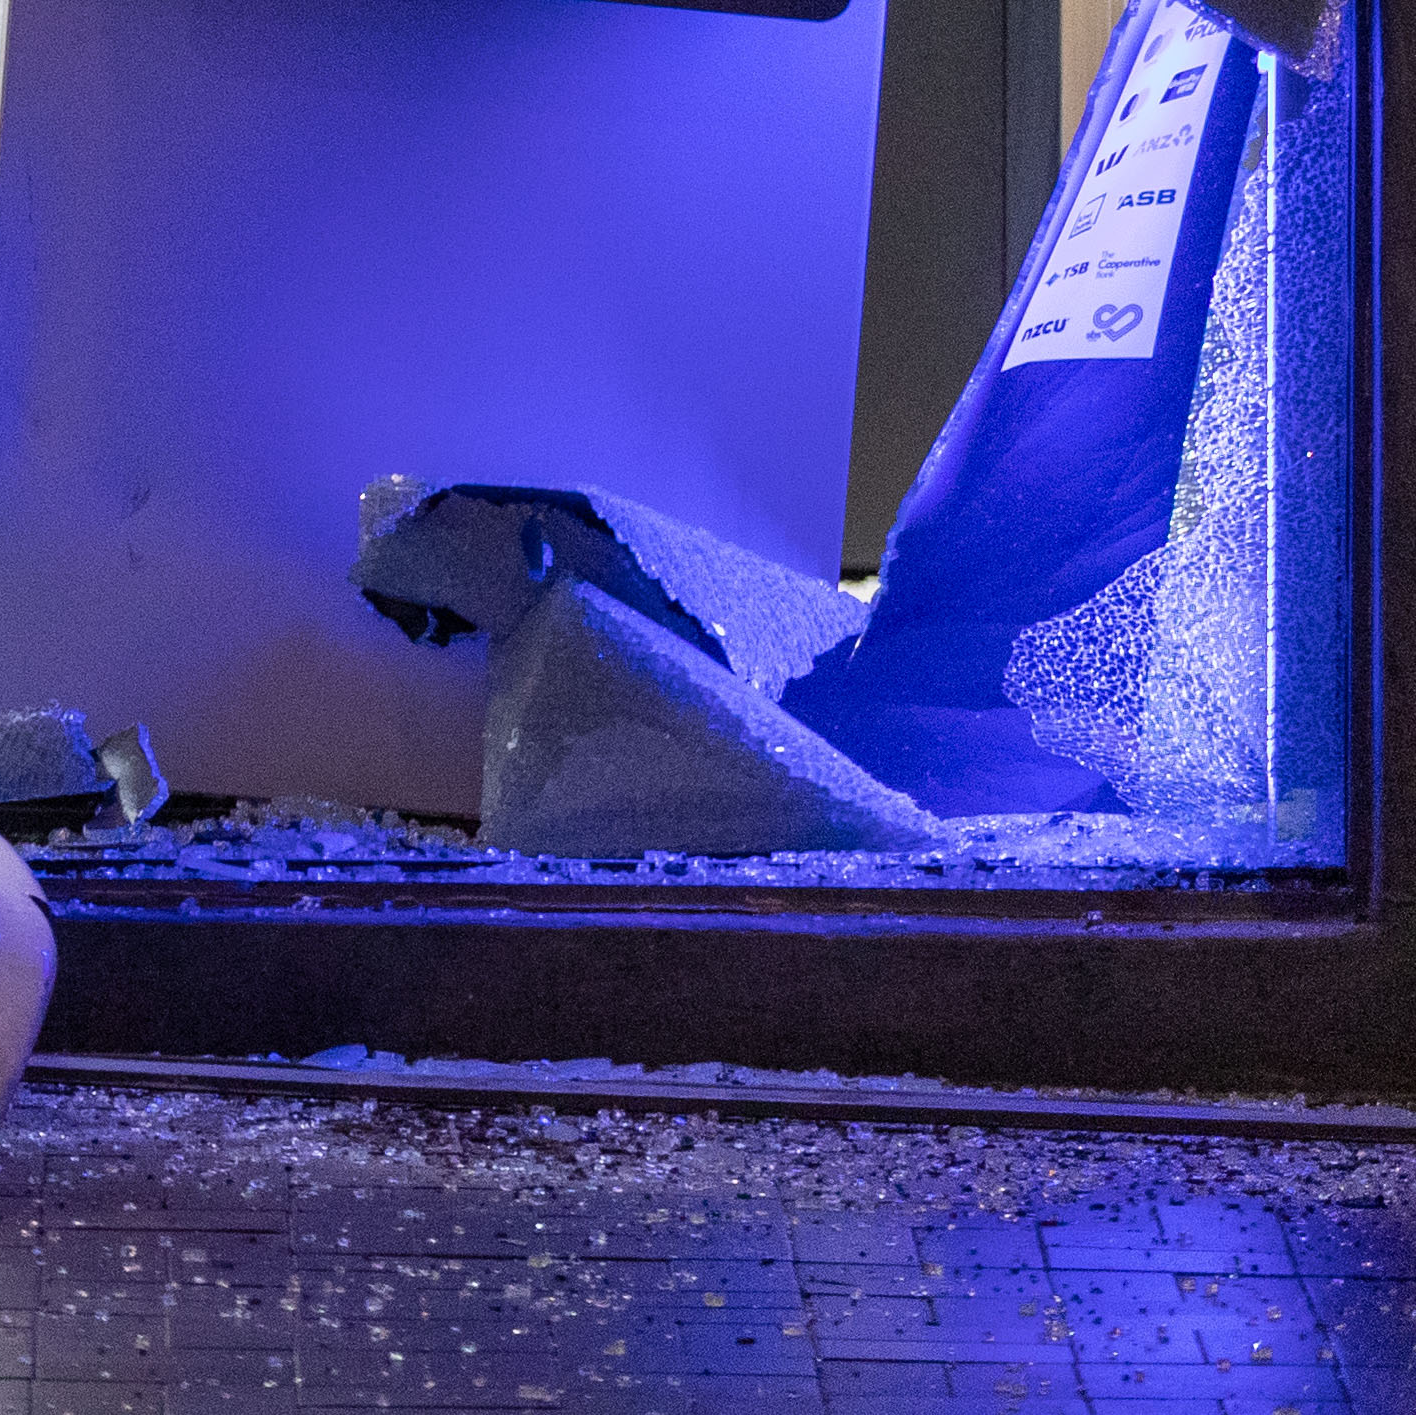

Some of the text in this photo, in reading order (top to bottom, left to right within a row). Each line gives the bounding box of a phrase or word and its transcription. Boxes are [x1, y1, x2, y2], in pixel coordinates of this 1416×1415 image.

[1132, 133, 1174, 157] ANZ
[1116, 188, 1177, 211] ASB
[1101, 250, 1115, 259] The
[1063, 261, 1090, 280] TSB
[1097, 257, 1161, 271] Cooperative
[1096, 271, 1114, 279] Bank
